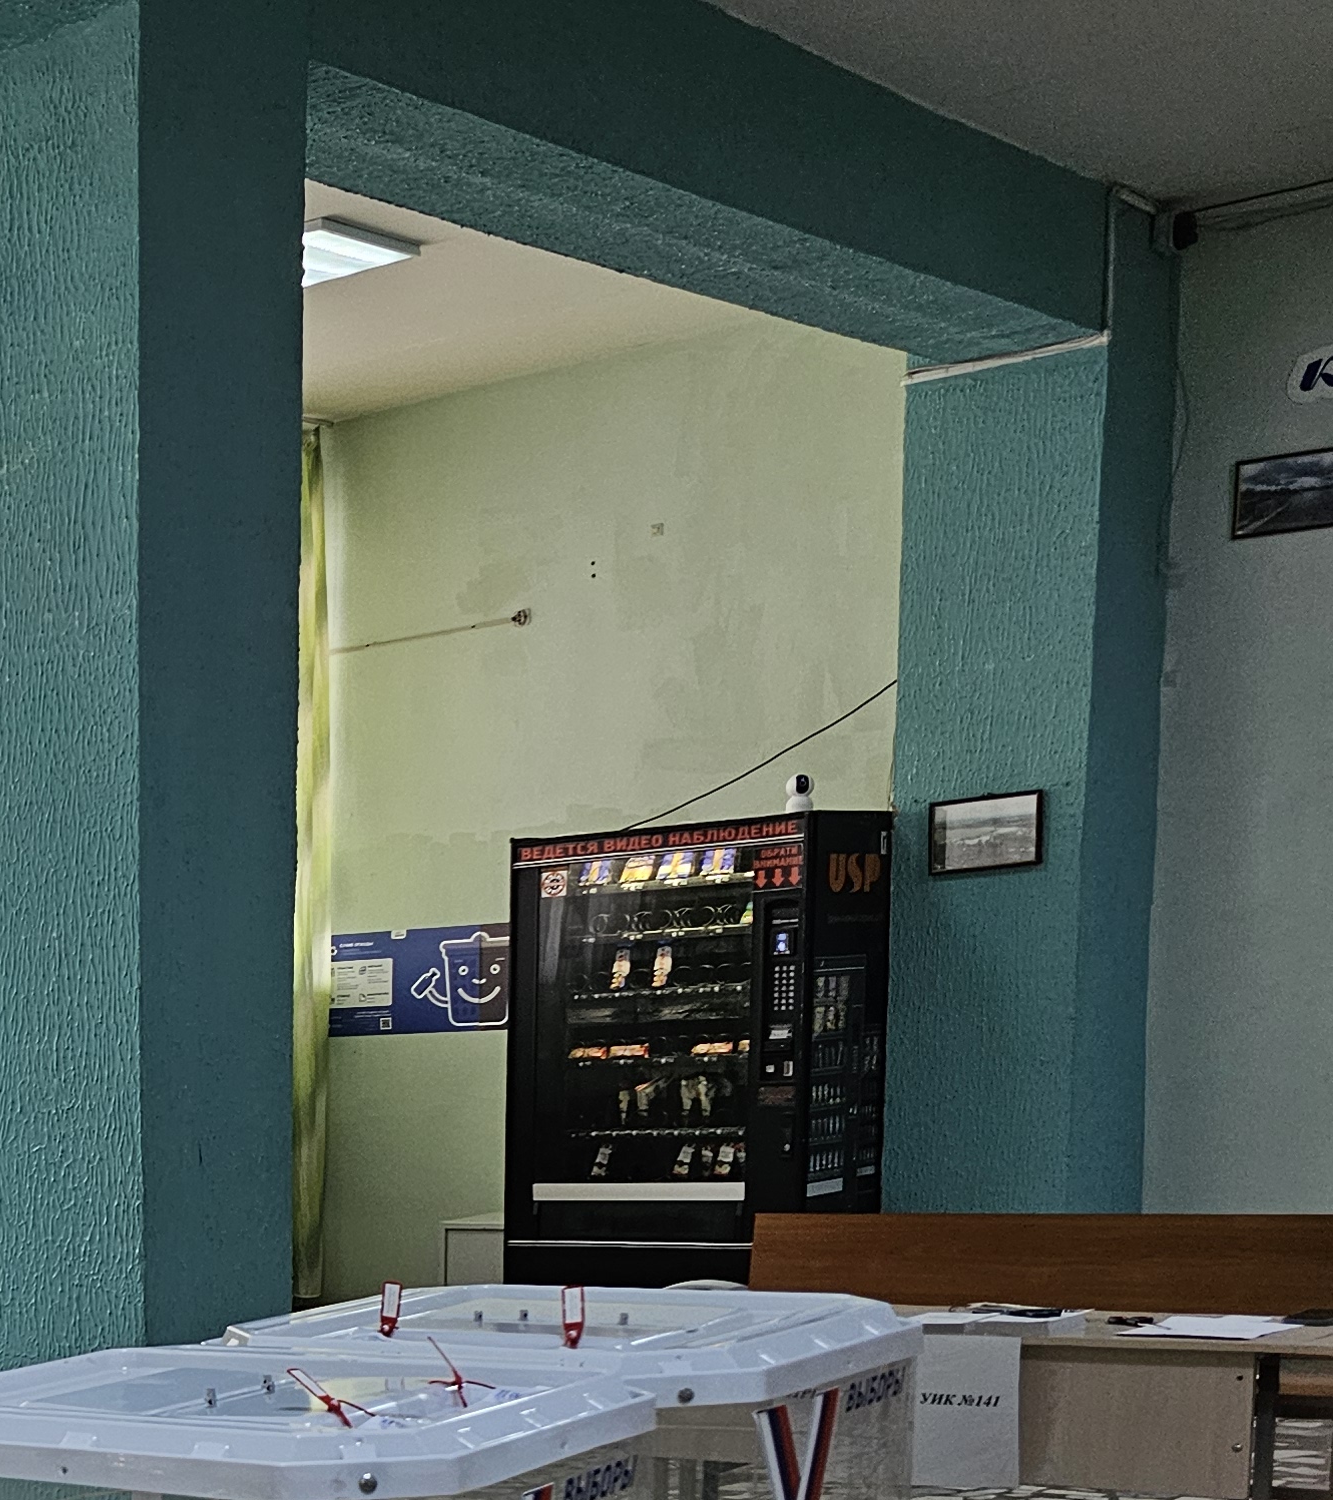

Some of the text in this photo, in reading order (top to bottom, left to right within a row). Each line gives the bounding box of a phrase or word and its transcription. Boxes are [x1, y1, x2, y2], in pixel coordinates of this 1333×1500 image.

[520, 820, 798, 861] ВЕДЕТСЯ ВИДЕО НАБЛЮДЕНИЕ
[829, 853, 881, 893] USP
[846, 1366, 906, 1413] ВЫБОРЫ
[920, 1393, 954, 1407] УИК
